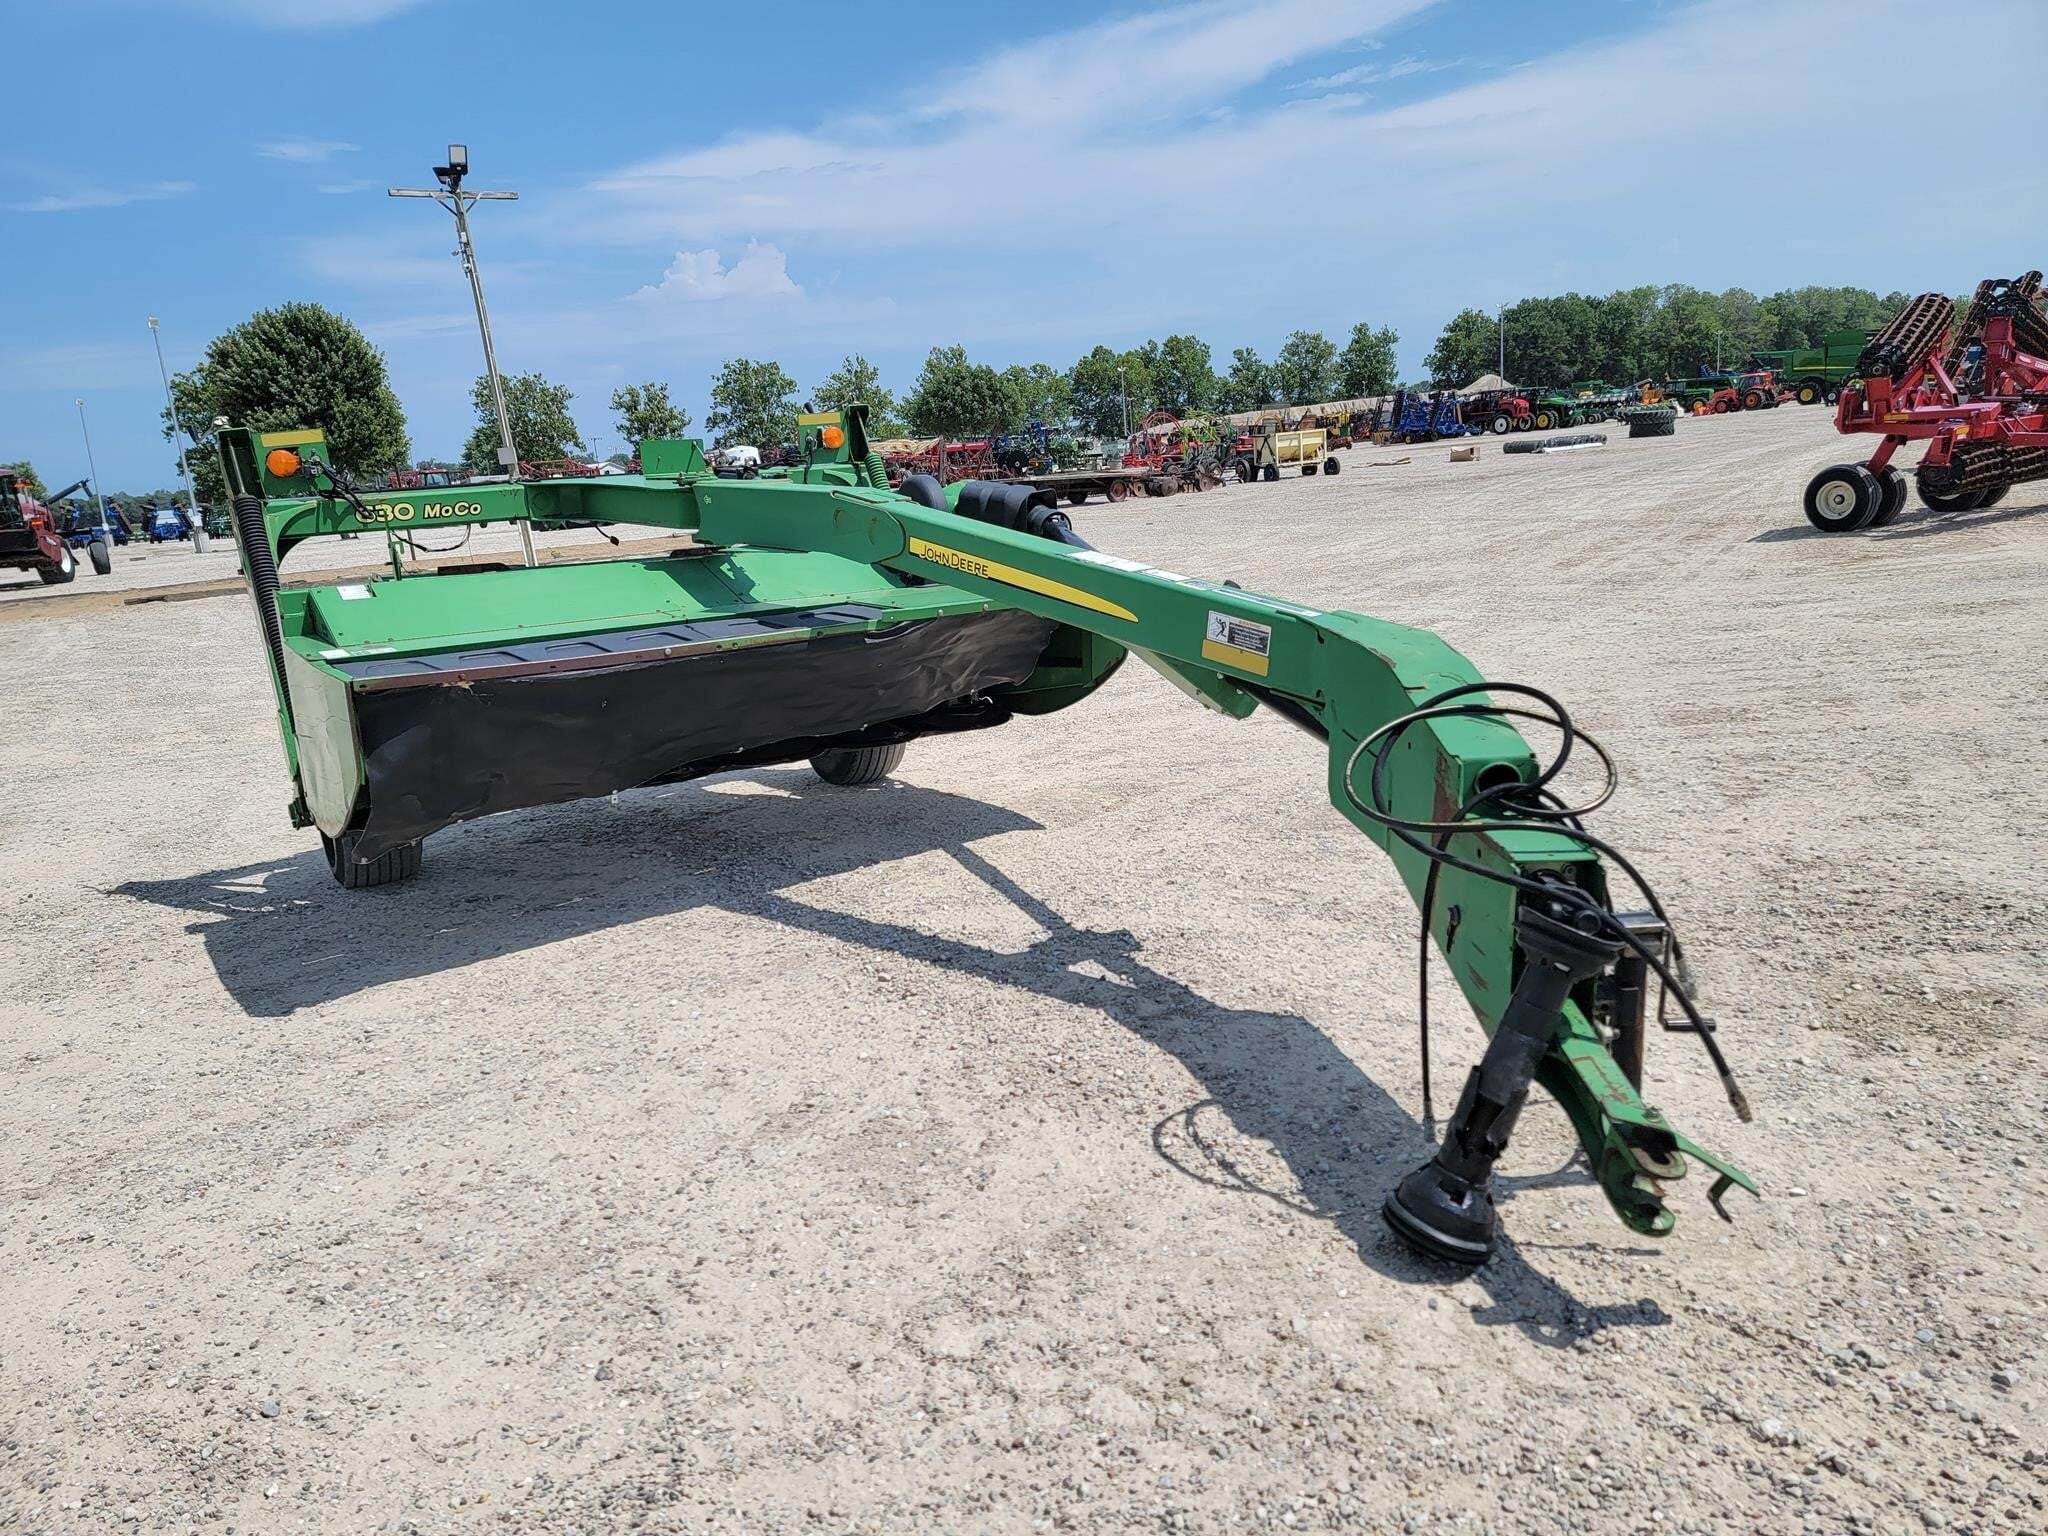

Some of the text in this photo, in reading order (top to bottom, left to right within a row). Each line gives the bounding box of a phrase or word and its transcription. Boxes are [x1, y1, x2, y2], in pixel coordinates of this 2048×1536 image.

[423, 501, 482, 519] MoCo
[920, 544, 989, 577] JOHN DEERE
